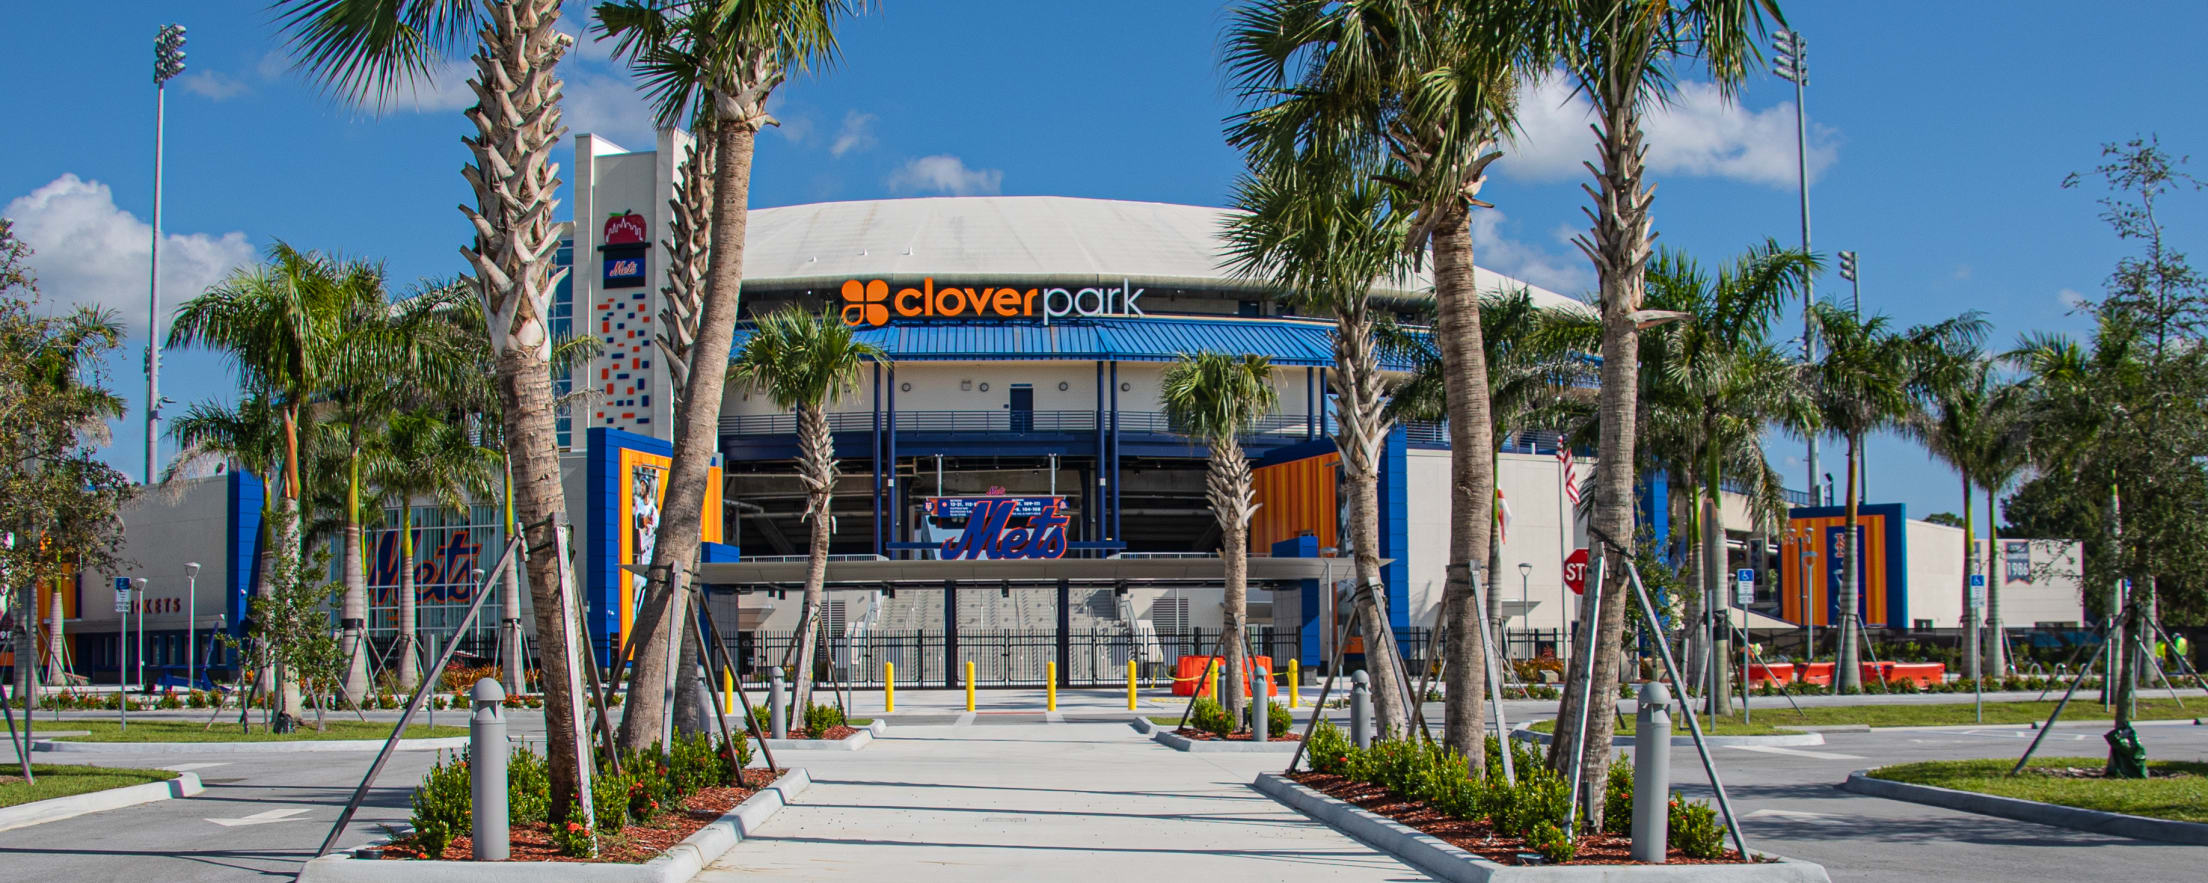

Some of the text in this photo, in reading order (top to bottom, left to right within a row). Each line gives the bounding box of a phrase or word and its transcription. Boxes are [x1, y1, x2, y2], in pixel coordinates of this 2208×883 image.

[609, 261, 638, 277] Mets
[940, 500, 1071, 560] Mets
[1565, 562, 1588, 581] ST
[2007, 562, 2029, 576] 1986
